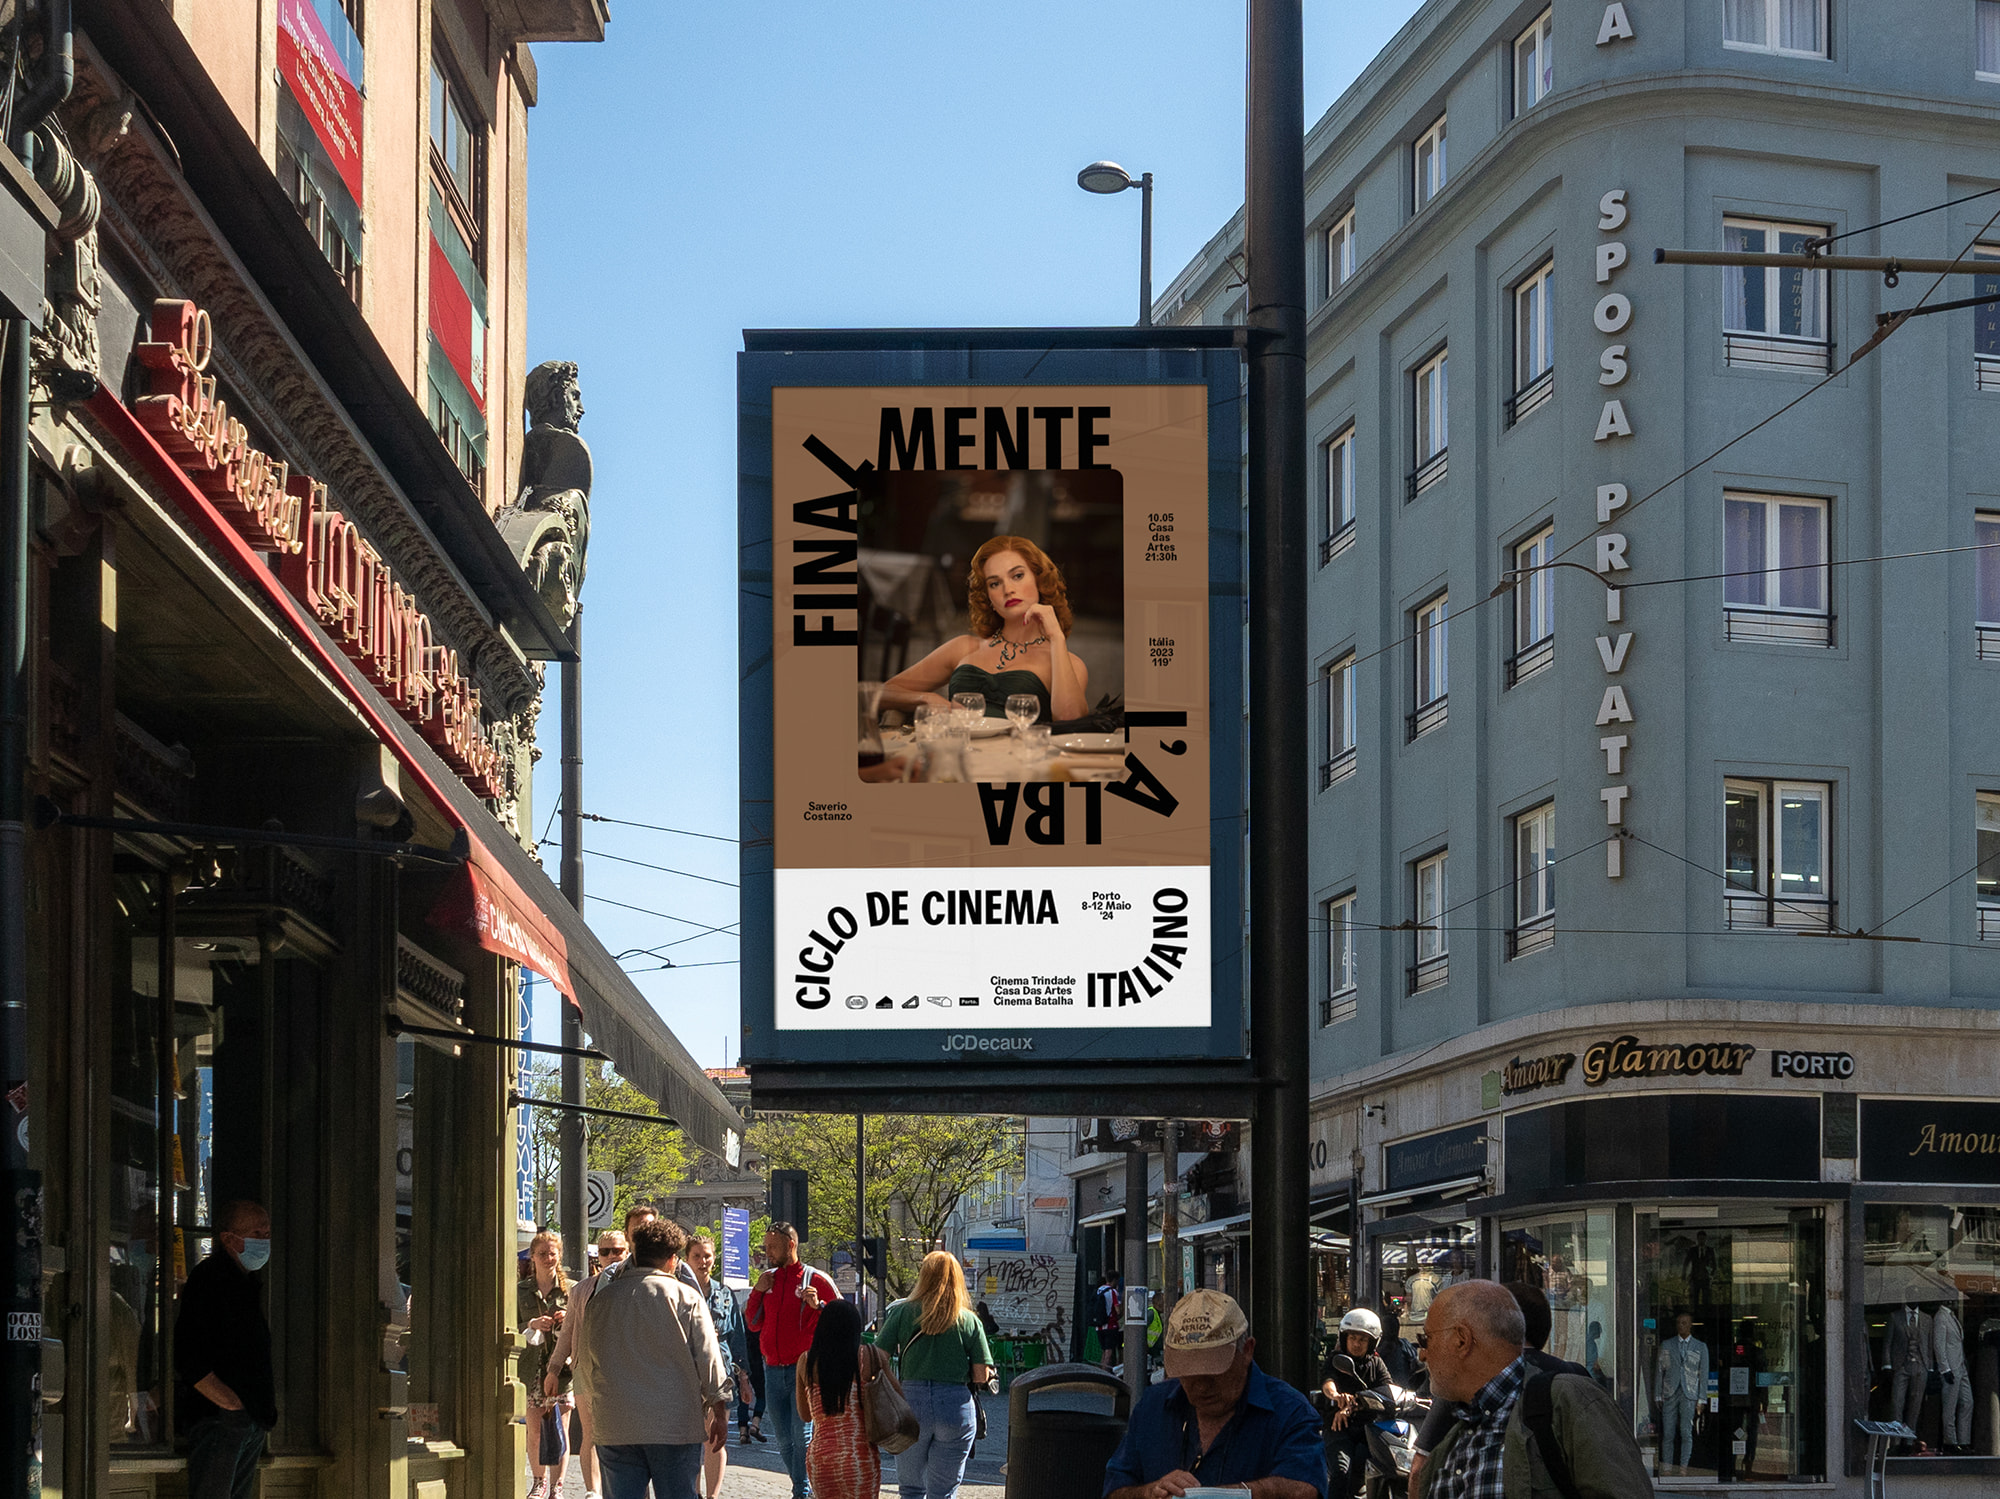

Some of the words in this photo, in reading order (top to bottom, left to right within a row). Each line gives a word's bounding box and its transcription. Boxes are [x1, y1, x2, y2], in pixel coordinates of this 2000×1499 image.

[1593, 190, 1634, 442] SPOSA
[1985, 283, 1998, 349] mour
[1147, 513, 1175, 522] 10.05
[1148, 523, 1174, 532] Casa
[1151, 532, 1171, 542] das
[1147, 542, 1176, 552] Artes
[1145, 552, 1178, 561] 21:30h
[1148, 636, 1175, 646] Itália
[1149, 647, 1174, 656] 2023
[1594, 483, 1634, 878] PRIVATTI
[808, 801, 848, 811] Saverio
[803, 811, 853, 821] Costanzo
[1092, 892, 1121, 901] Porto
[1081, 901, 1103, 910] 8-12
[1105, 901, 1132, 910] Maio
[795, 906, 858, 1010] CICLO
[865, 890, 909, 927] DE
[921, 889, 1059, 926] CINEMA
[1087, 887, 1189, 1008] ITALIANO
[990, 975, 1029, 986] Cinema
[1031, 975, 1076, 986] Trindade
[994, 986, 1020, 996] Casa
[1022, 986, 1042, 996] Das
[1044, 986, 1073, 996] Artes
[993, 996, 1032, 1006] Cinema
[1034, 996, 1074, 1006] Batalha
[941, 1034, 1033, 1052] JCDecaux
[1503, 1054, 1574, 1091] Amour
[1583, 1039, 1755, 1083] Glamour
[1776, 1053, 1854, 1076] PORTO
[1909, 1123, 2000, 1157] Amou
